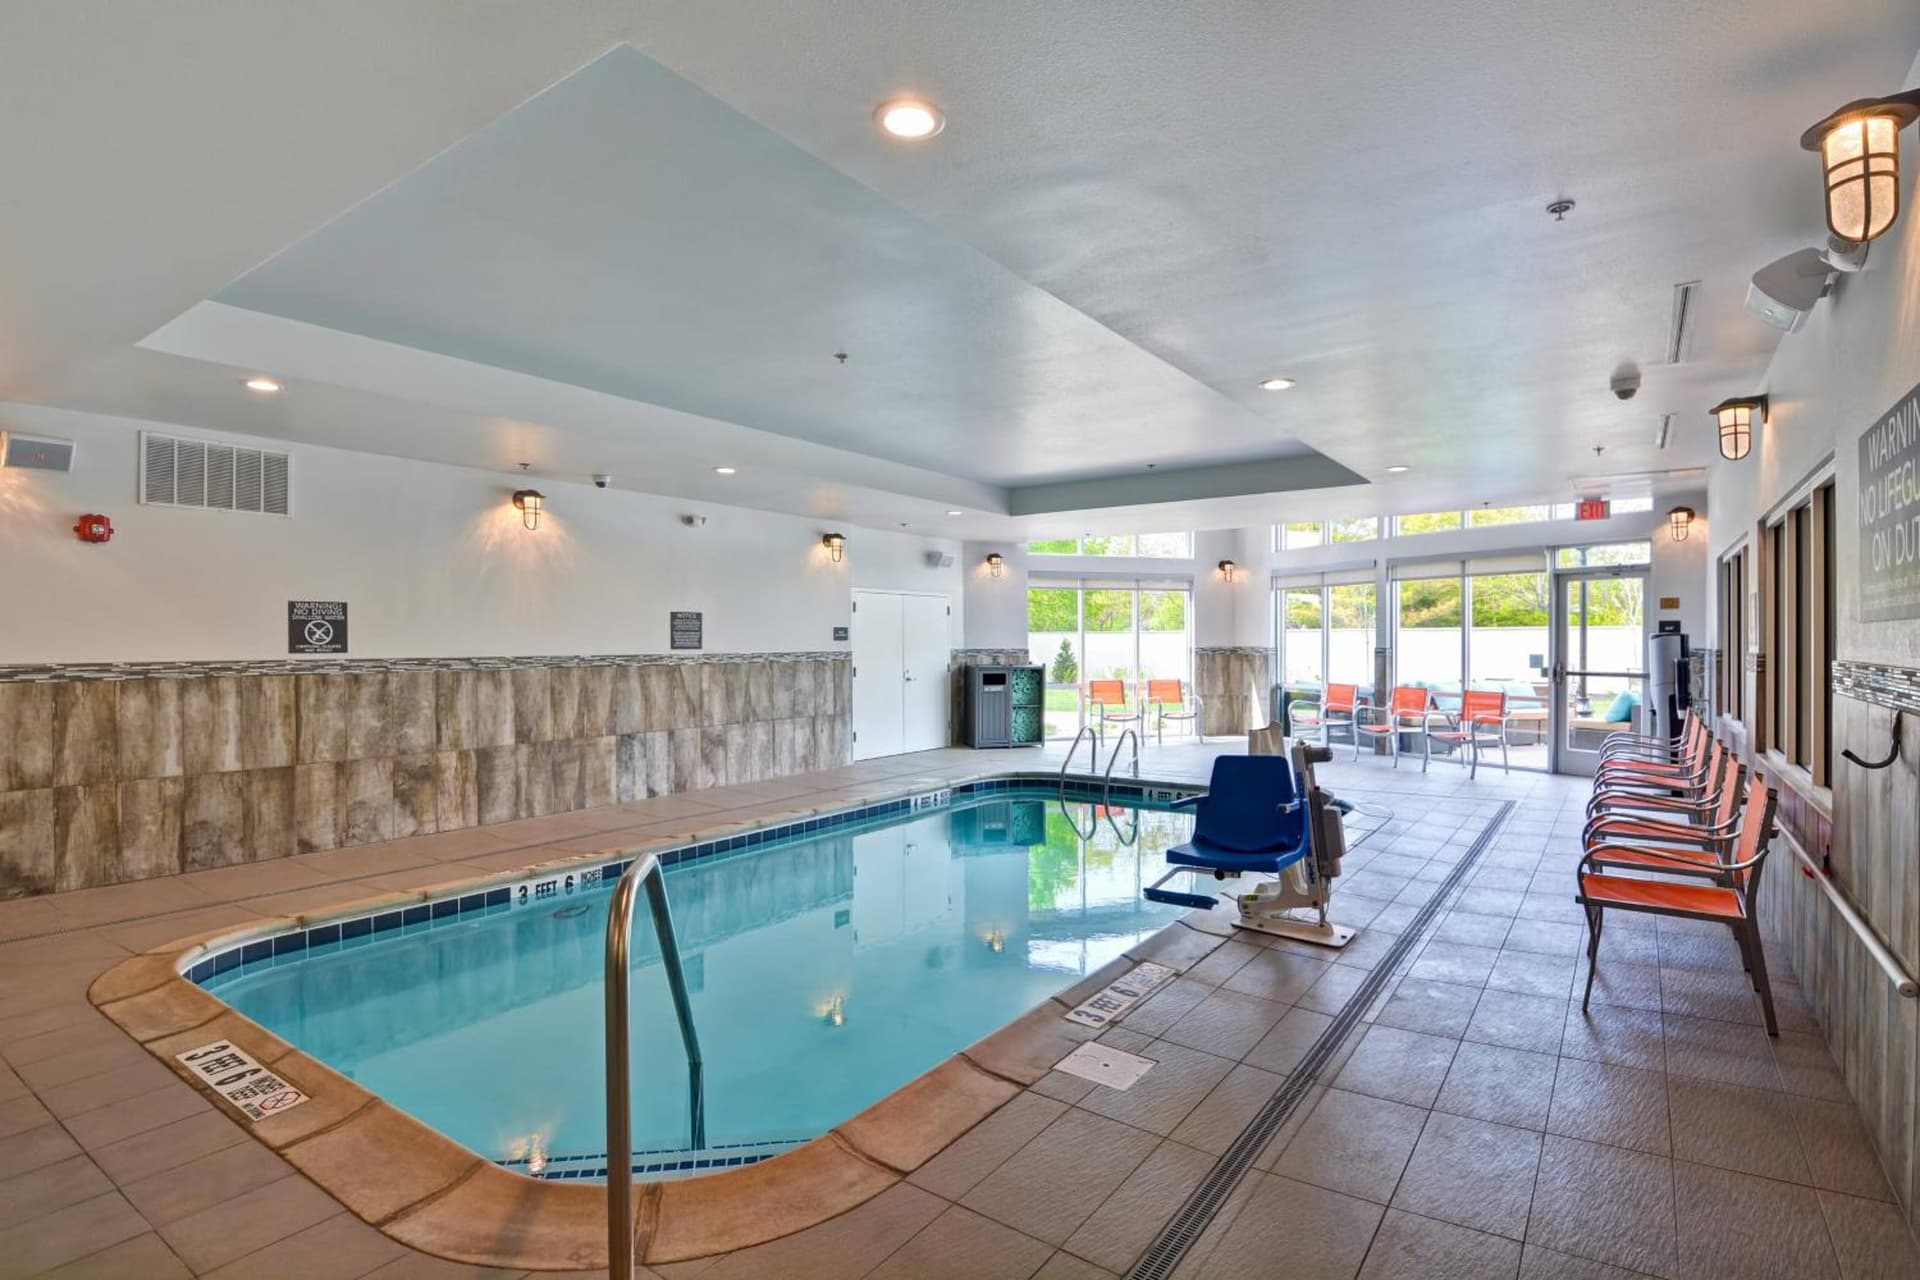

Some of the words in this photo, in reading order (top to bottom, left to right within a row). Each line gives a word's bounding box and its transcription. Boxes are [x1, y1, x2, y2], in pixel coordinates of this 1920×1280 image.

[1868, 397, 1920, 472] WARNIN
[1581, 502, 1605, 519] EXIT
[1860, 485, 1876, 529] NO
[1872, 532, 1891, 573] ON
[293, 608, 308, 616] NO
[311, 608, 343, 616] DIVING
[535, 880, 558, 897] FEET
[564, 875, 574, 893] 6
[1073, 1010, 1106, 1023] 3
[1110, 985, 1140, 997] 6
[183, 1044, 230, 1061] 3
[197, 1053, 248, 1076] FEET
[214, 1067, 263, 1086] 6
